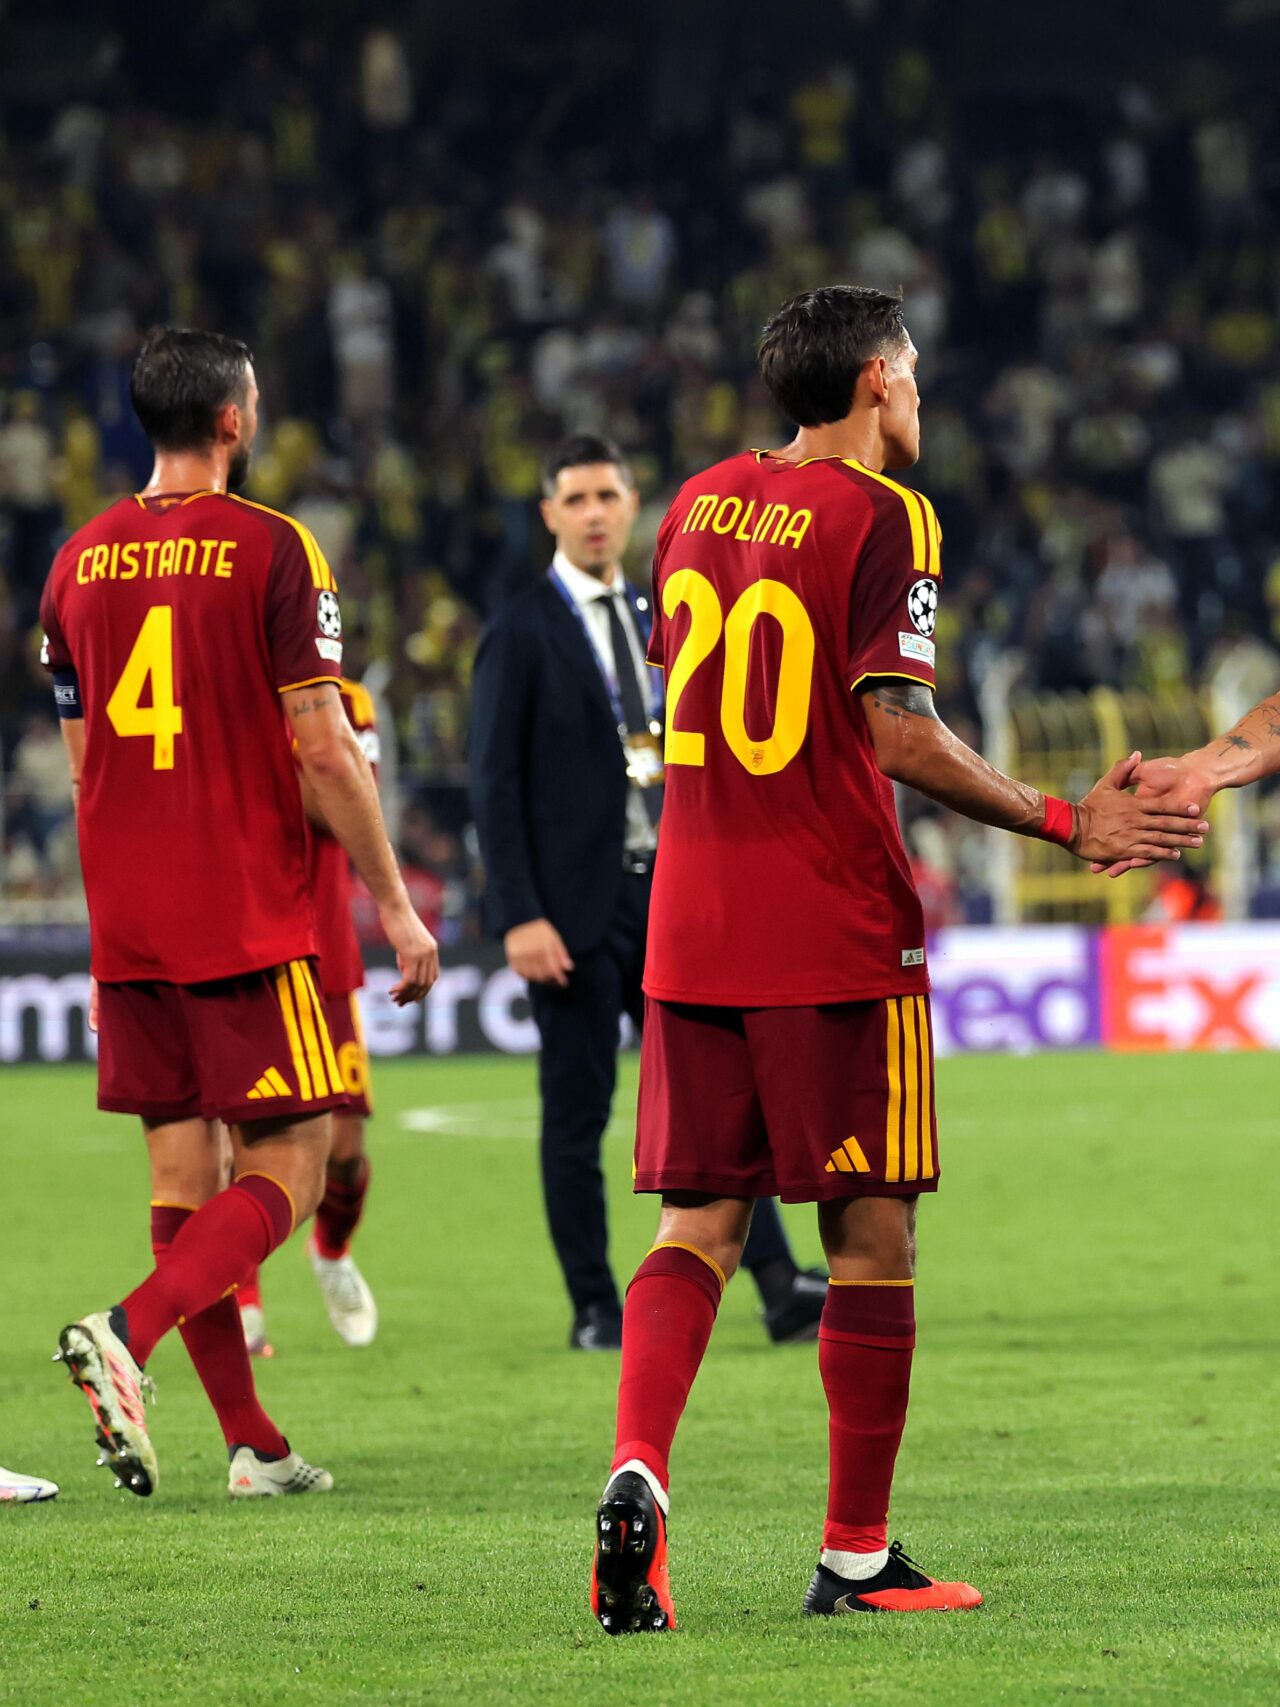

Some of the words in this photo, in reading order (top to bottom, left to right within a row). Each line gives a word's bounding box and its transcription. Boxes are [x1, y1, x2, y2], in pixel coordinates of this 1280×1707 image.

[77, 537, 237, 585] CRISTANTE
[682, 494, 812, 549] MOLINA
[106, 605, 182, 770] 4
[662, 569, 815, 776] 20
